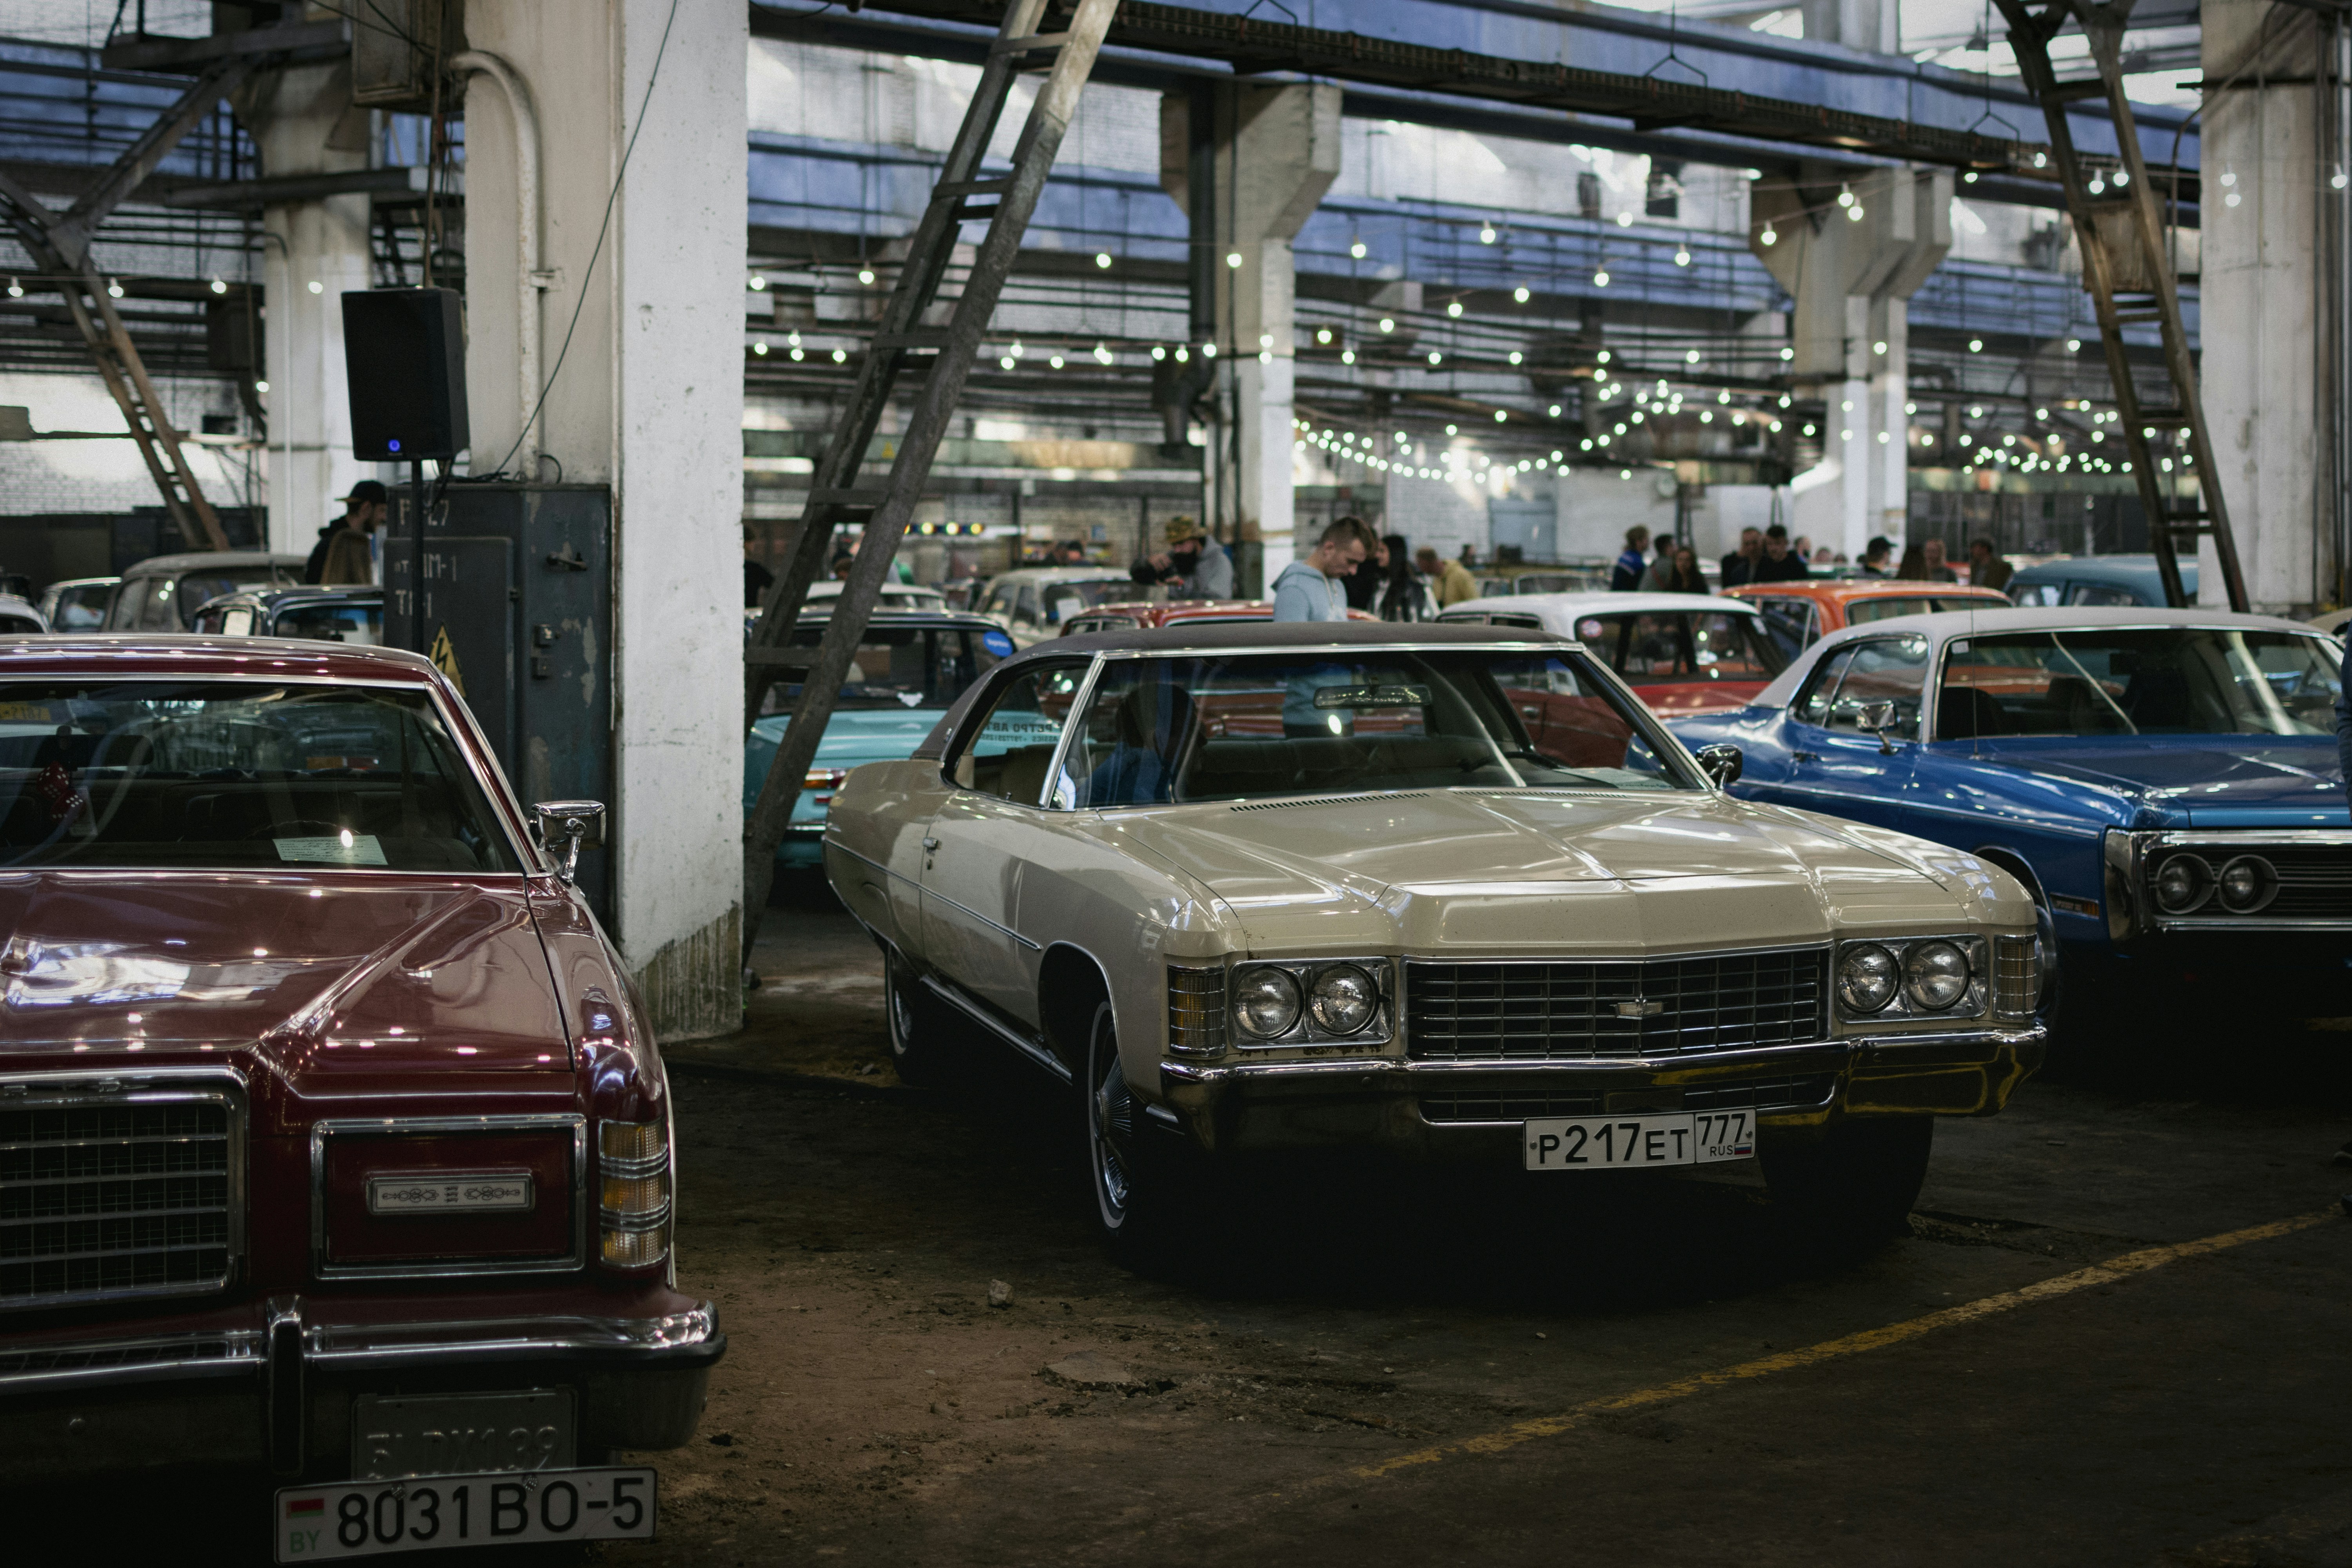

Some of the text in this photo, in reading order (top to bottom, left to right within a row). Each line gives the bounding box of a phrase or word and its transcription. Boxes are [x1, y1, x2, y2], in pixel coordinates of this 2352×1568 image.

[1539, 1112, 1746, 1164] P217ET 777
[1710, 1145, 1733, 1157] RUS
[289, 1530, 321, 1553] BY
